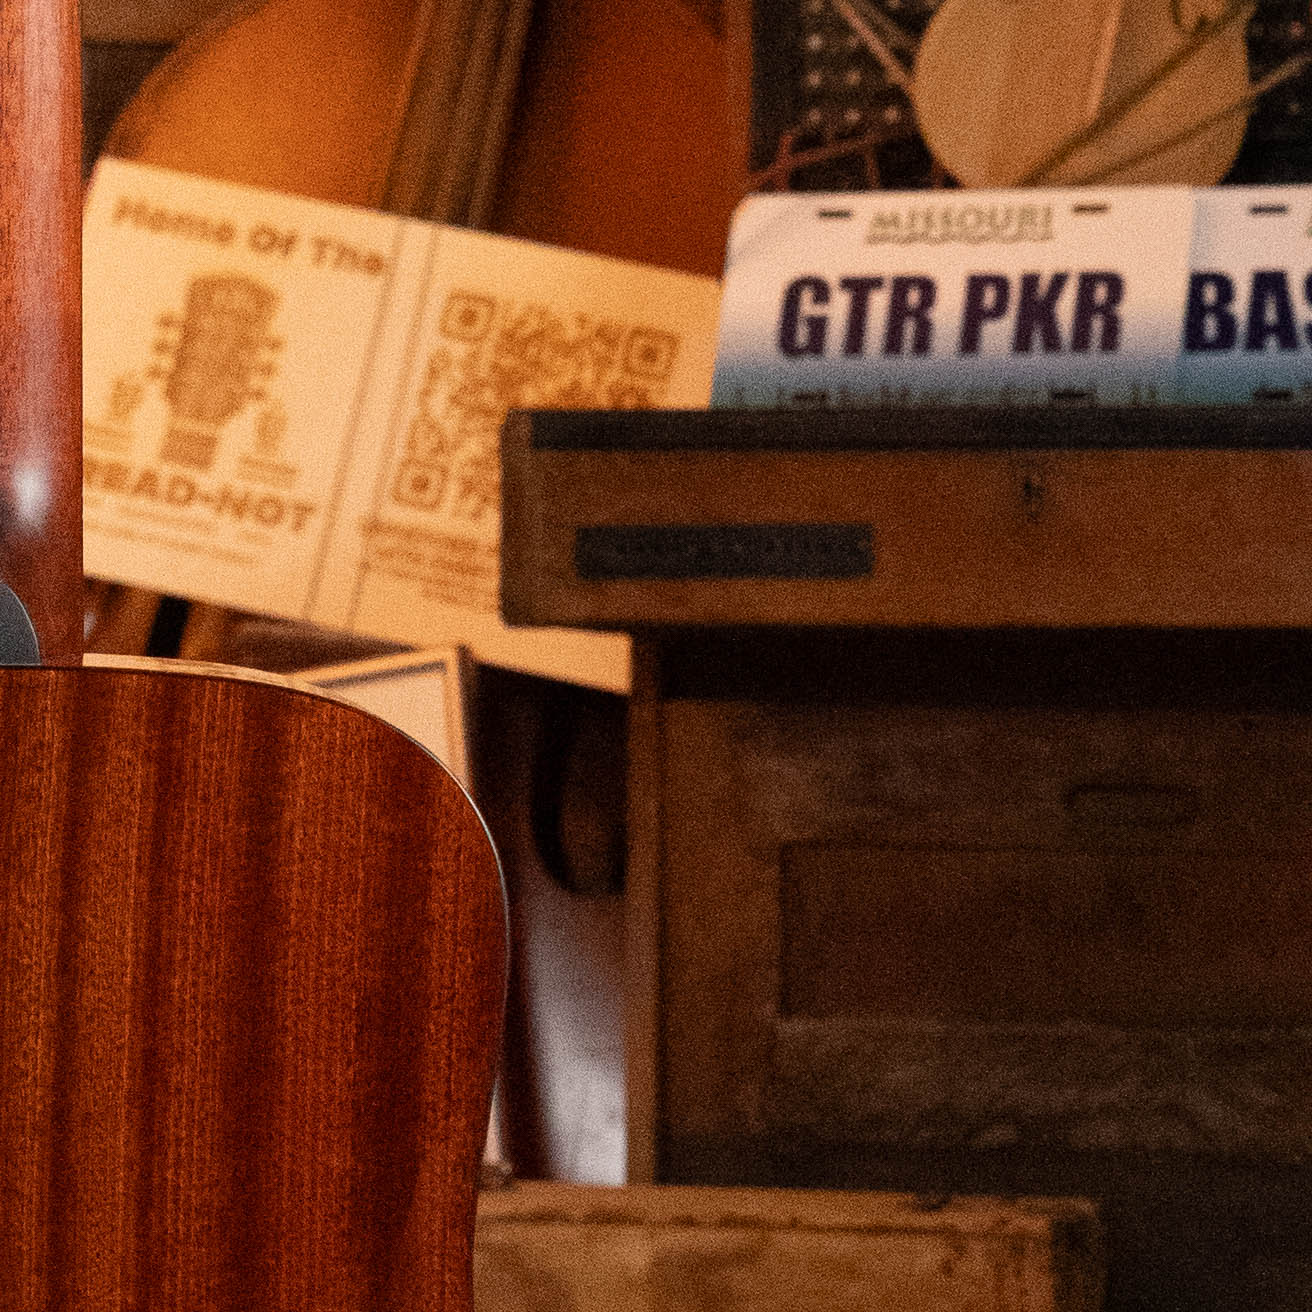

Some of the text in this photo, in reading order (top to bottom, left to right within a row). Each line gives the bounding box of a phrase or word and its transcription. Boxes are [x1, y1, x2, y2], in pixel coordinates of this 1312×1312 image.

[313, 237, 386, 277] The
[778, 270, 1125, 359] GTR PKR
[1182, 268, 1312, 354] BA
